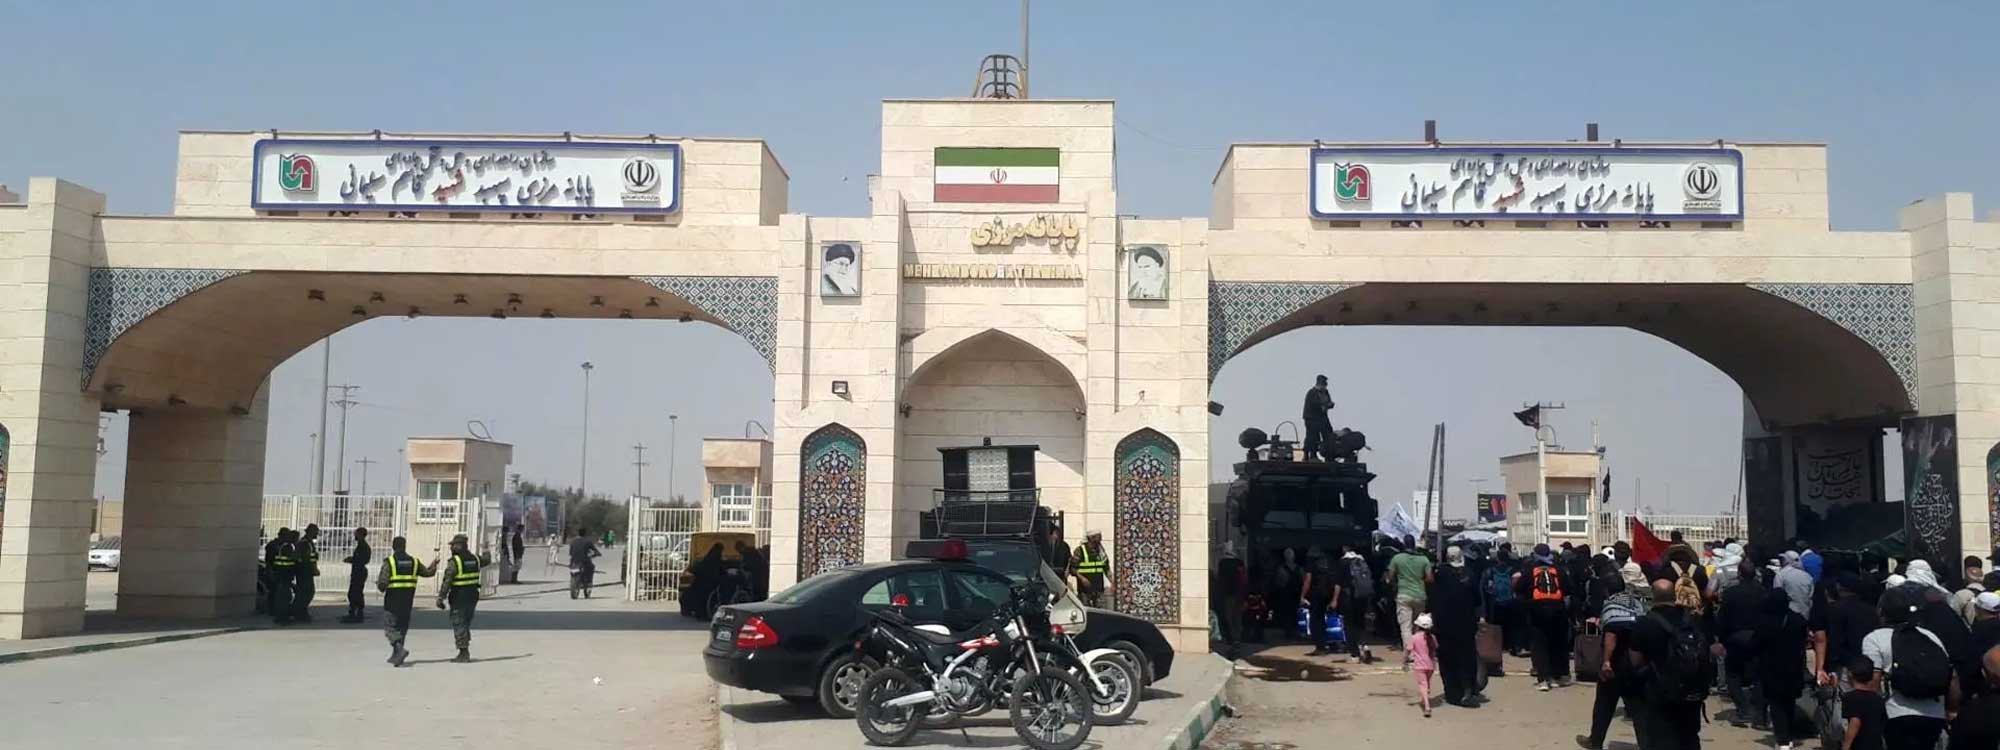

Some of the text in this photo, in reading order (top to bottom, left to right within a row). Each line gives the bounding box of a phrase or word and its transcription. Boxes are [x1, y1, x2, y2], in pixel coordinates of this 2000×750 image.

[339, 163, 595, 205] پایانه مرزی سپهبد شهید قاسم سلیمانی
[1400, 172, 1655, 213] پایانه مرزی سپهبد شهید قاسم سلیمانی
[970, 212, 1080, 256] پایانه مرزی
[903, 263, 961, 279] MEHRAN
